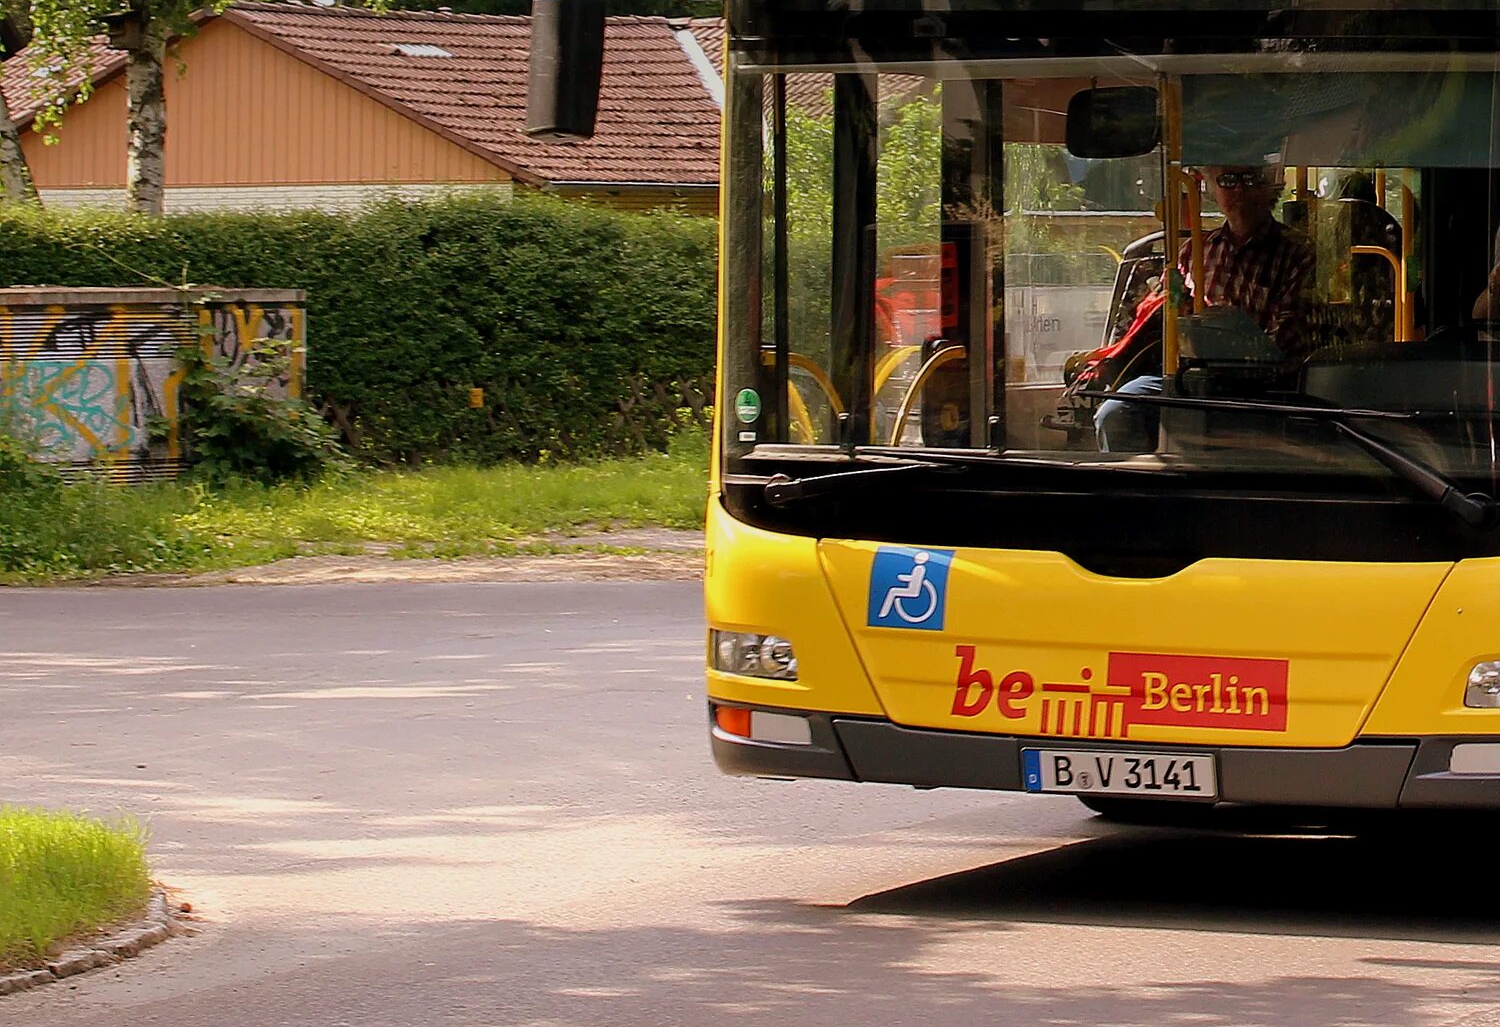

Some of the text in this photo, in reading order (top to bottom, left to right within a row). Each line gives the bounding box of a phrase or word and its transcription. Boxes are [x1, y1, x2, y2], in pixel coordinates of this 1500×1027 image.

[1141, 671, 1270, 716] Berlin
[1054, 755, 1201, 791] B V 3141
